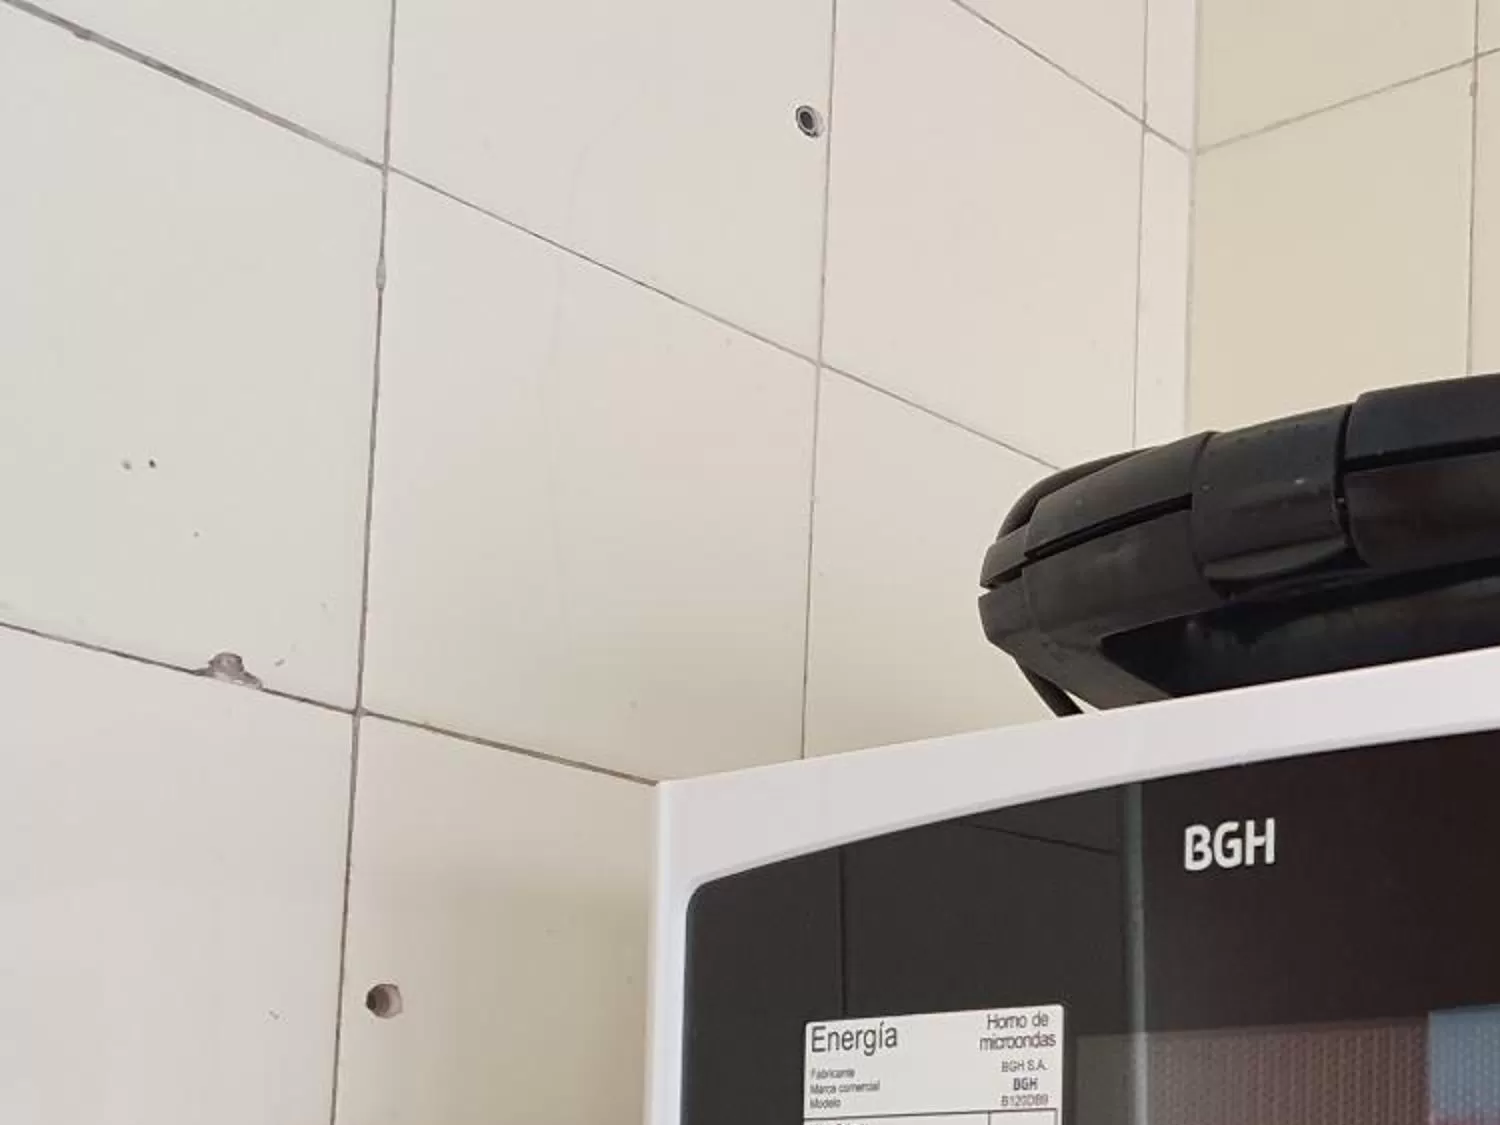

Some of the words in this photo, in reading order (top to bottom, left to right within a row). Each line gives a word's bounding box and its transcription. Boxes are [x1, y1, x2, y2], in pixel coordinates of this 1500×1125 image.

[1185, 818, 1275, 871] BGH
[987, 1014, 1027, 1030] Horno
[1032, 1011, 1049, 1027] de
[810, 1021, 898, 1056] Energía
[979, 1031, 1056, 1051] microondas
[1001, 1060, 1025, 1072] BGH
[811, 1068, 855, 1080] Fabricante
[810, 1083, 837, 1095] Marca
[838, 1080, 881, 1093] comercial
[1012, 1078, 1038, 1091] BGH
[810, 1098, 841, 1109] Modelo
